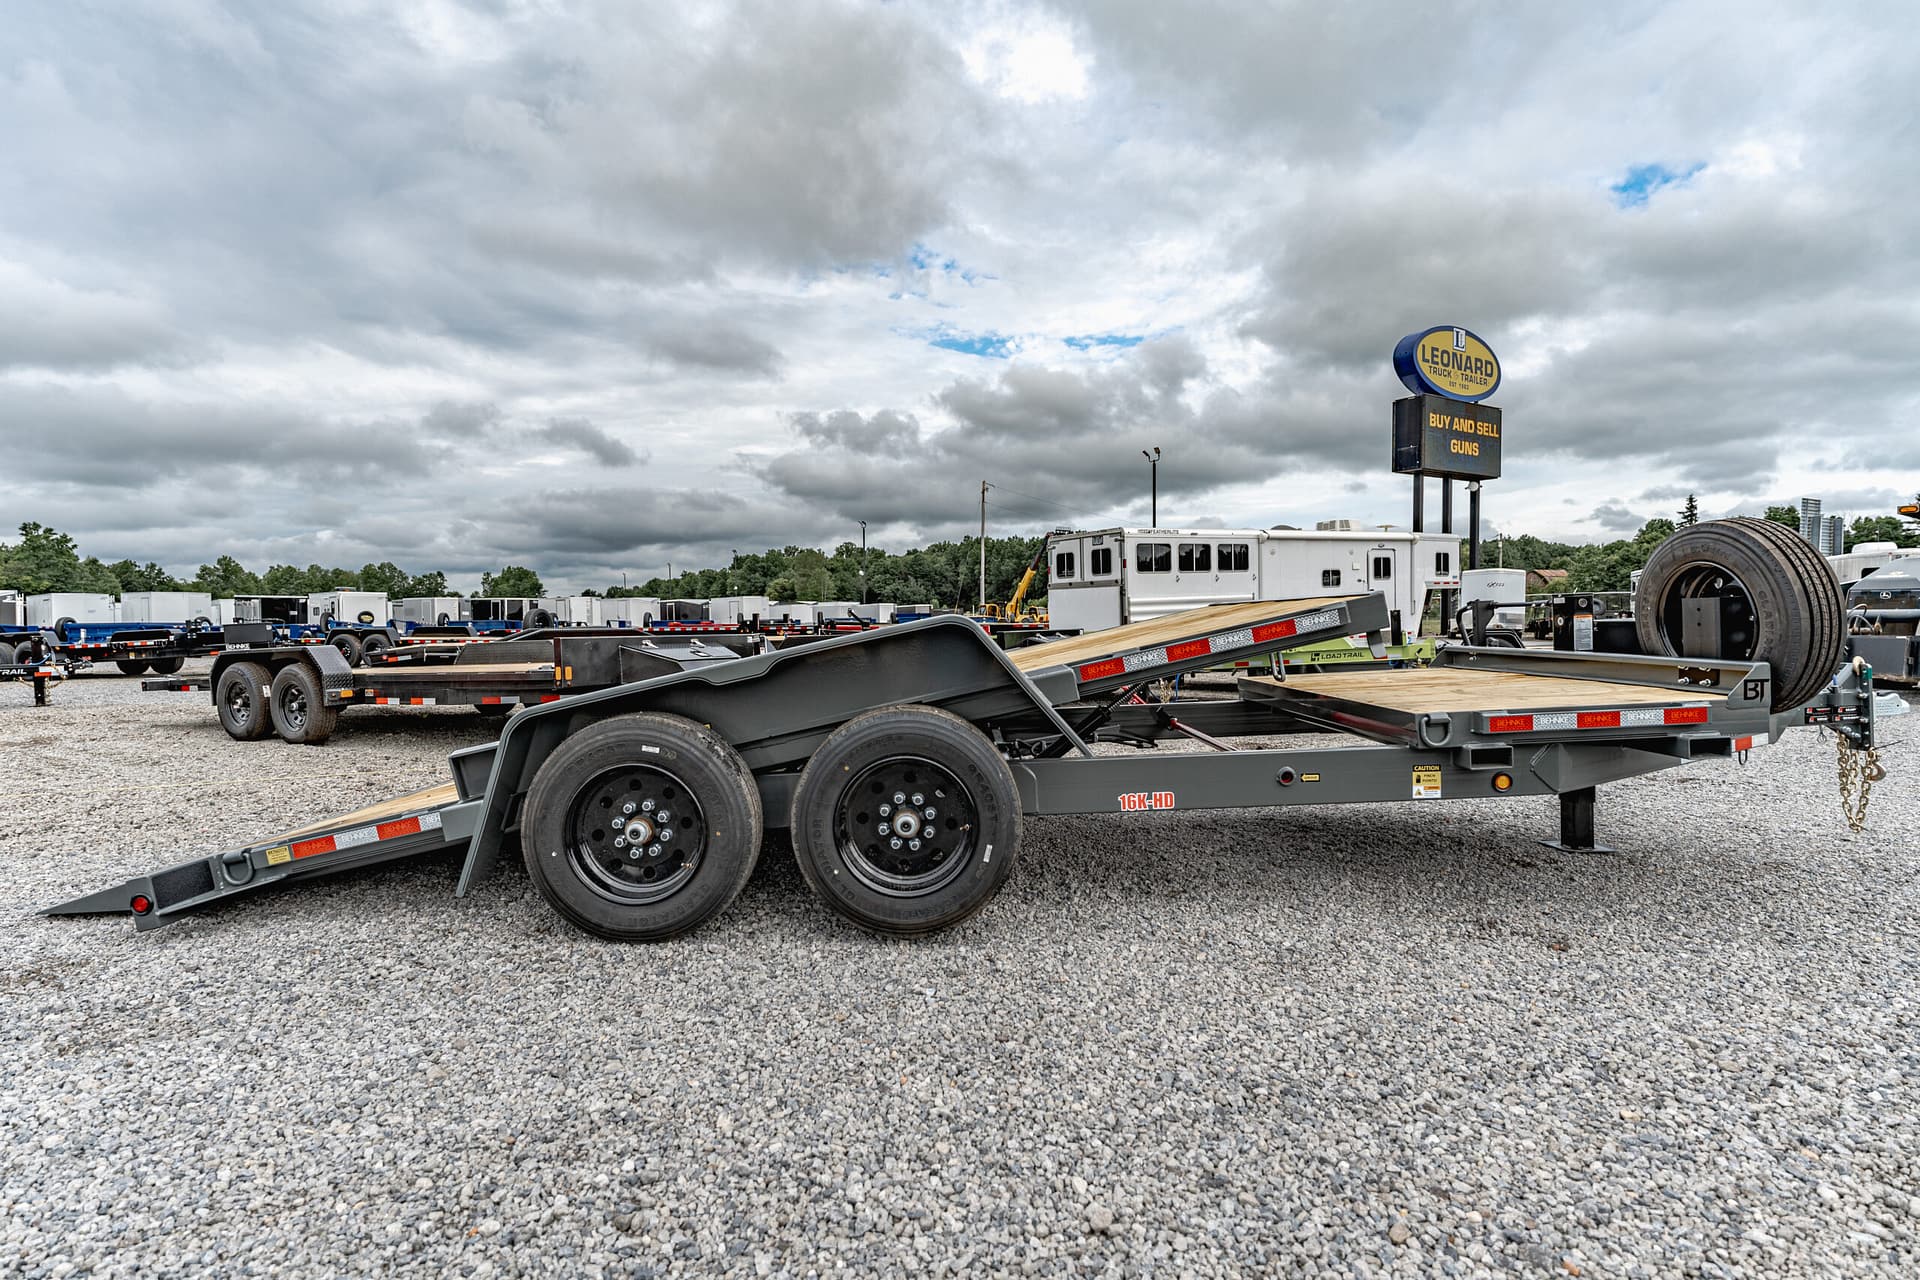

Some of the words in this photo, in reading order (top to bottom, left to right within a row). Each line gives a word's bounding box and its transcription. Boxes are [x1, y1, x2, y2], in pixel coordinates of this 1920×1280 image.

[1422, 344, 1494, 378] LEONARD
[1429, 366, 1452, 379] TRUCK
[1461, 373, 1488, 386] TRAILER
[1429, 412, 1451, 429] BUY
[1452, 417, 1475, 433] AND
[1477, 421, 1499, 438] SELL
[1450, 439, 1480, 456] GUNS
[1131, 653, 1160, 664] BEHNKE
[1216, 634, 1245, 645] BEHNKE
[1302, 614, 1331, 626] BEHNKE
[0, 668, 28, 676] RAIL
[1497, 719, 1525, 728] BEHNKE
[1540, 717, 1569, 725] BEHNKE
[1584, 715, 1612, 723] BEHNKE
[1628, 712, 1656, 721] BEHNKE
[1671, 711, 1700, 720] BEHNKE
[1413, 764, 1441, 772] CAUTION
[1119, 792, 1174, 810] 16K-HD
